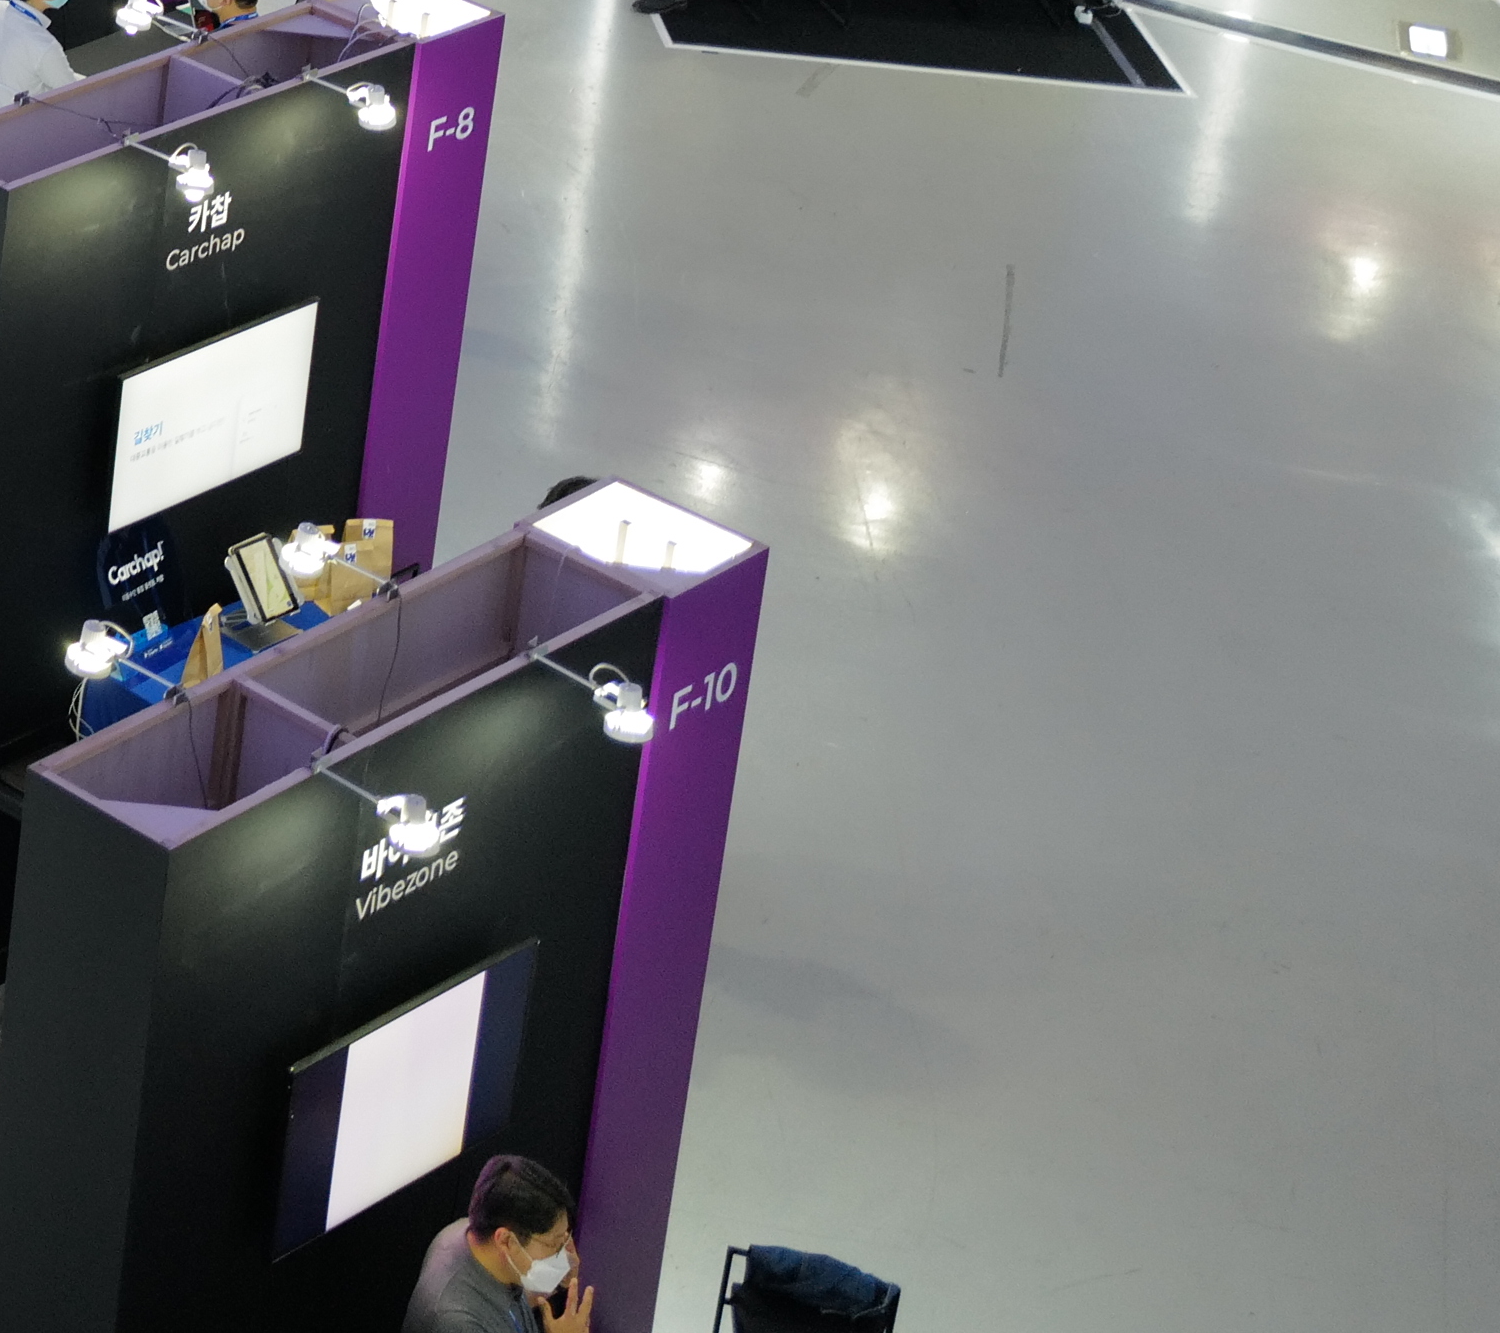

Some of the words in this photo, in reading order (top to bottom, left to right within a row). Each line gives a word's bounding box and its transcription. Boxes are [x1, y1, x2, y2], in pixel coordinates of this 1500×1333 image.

[427, 107, 475, 152] F-8
[187, 190, 233, 233] 카찹
[165, 224, 246, 272] Carchap
[107, 539, 166, 586] Carchap!
[668, 661, 739, 732] F-10
[354, 848, 459, 923] Vibezone
